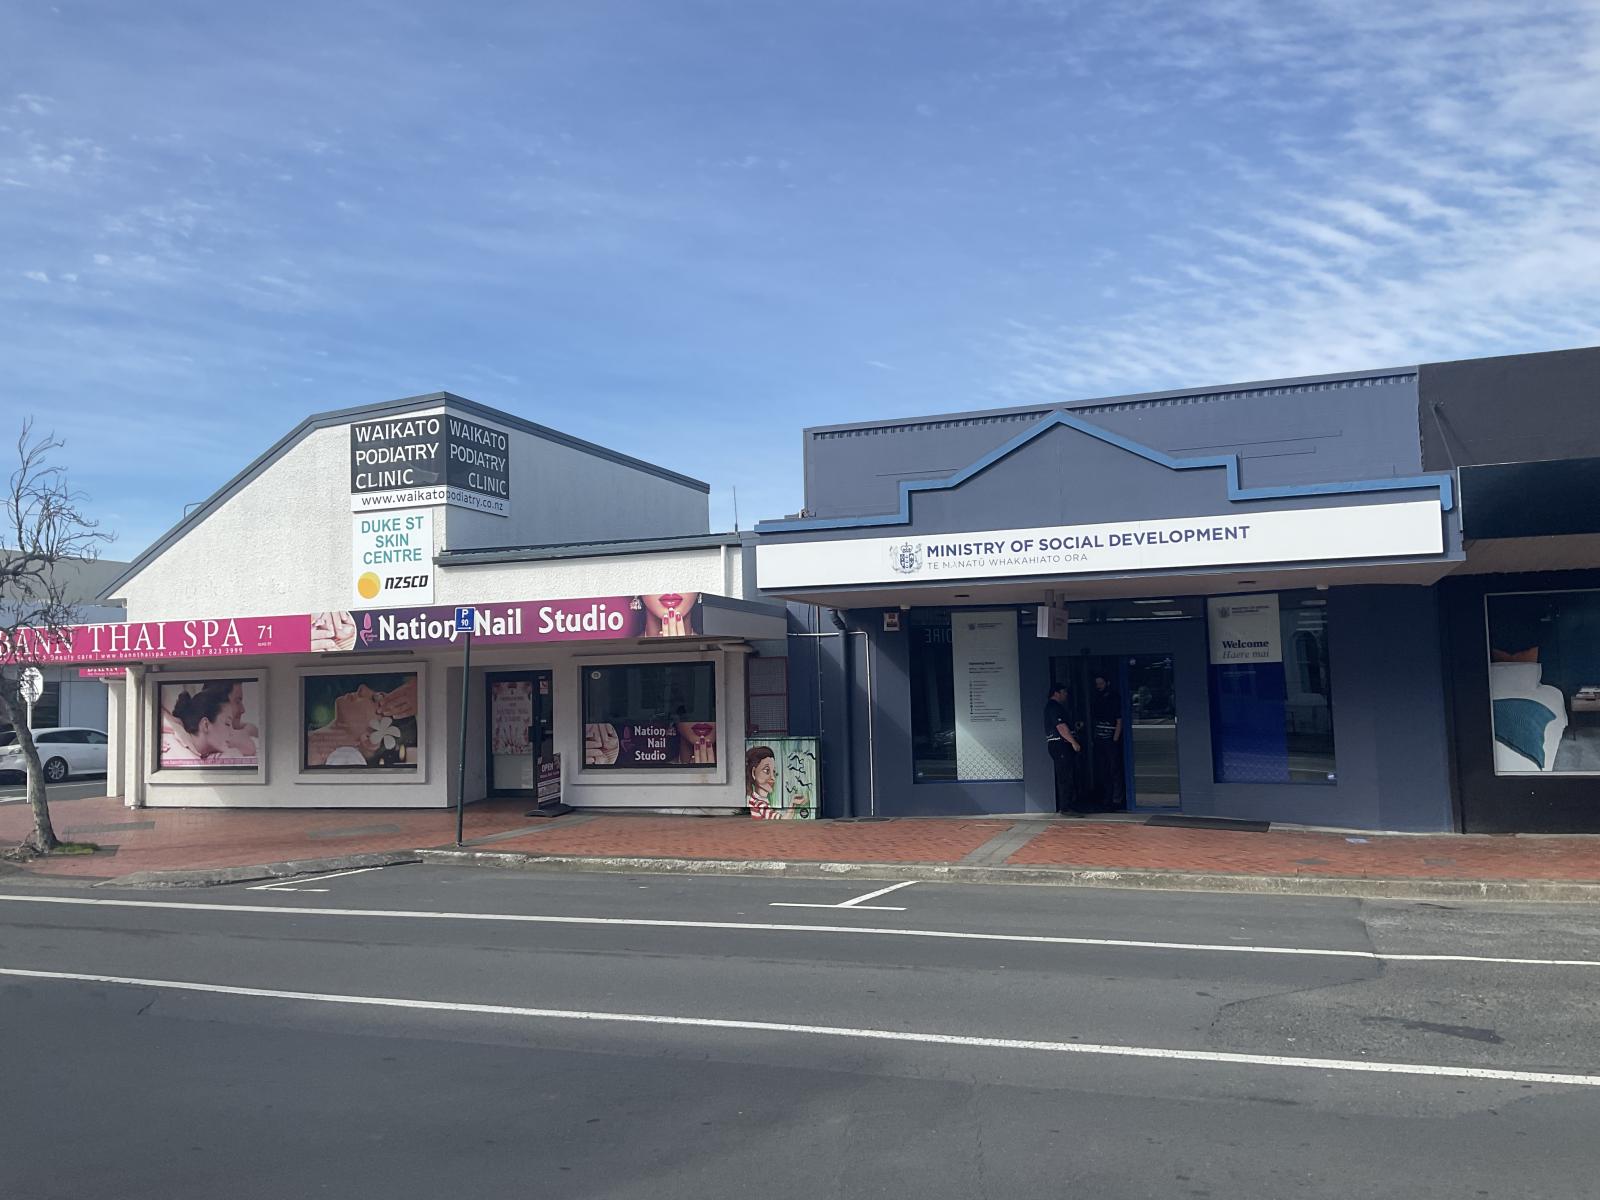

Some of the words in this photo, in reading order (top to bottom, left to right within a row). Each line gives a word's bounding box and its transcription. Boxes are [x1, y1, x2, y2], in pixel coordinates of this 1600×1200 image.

[355, 418, 440, 443] WAIKATO
[449, 419, 506, 451] WAIKATO
[355, 442, 440, 466] PODIATRY
[450, 443, 506, 473] PODIATRY
[355, 468, 414, 490] CLINIC
[468, 472, 507, 496] CLINIC
[361, 517, 402, 534] DUKE
[405, 515, 424, 531] ST
[375, 533, 409, 549] SKIN
[926, 541, 1006, 558] MINISTRY
[1010, 539, 1034, 553] OF
[1038, 535, 1104, 551] SOCIAL
[1109, 525, 1251, 547] DEVELOPMENT
[363, 548, 423, 565] CENTRE
[927, 561, 940, 570] TE
[1064, 553, 1088, 563] ORA
[461, 608, 469, 618] P
[475, 608, 522, 637] Nail
[538, 603, 624, 634] Studio
[87, 623, 167, 653] THAI
[183, 618, 244, 650] SPA
[257, 625, 273, 640] 71
[1222, 639, 1270, 649] Welcome
[647, 738, 666, 748] Nail
[634, 750, 666, 761] Studio
